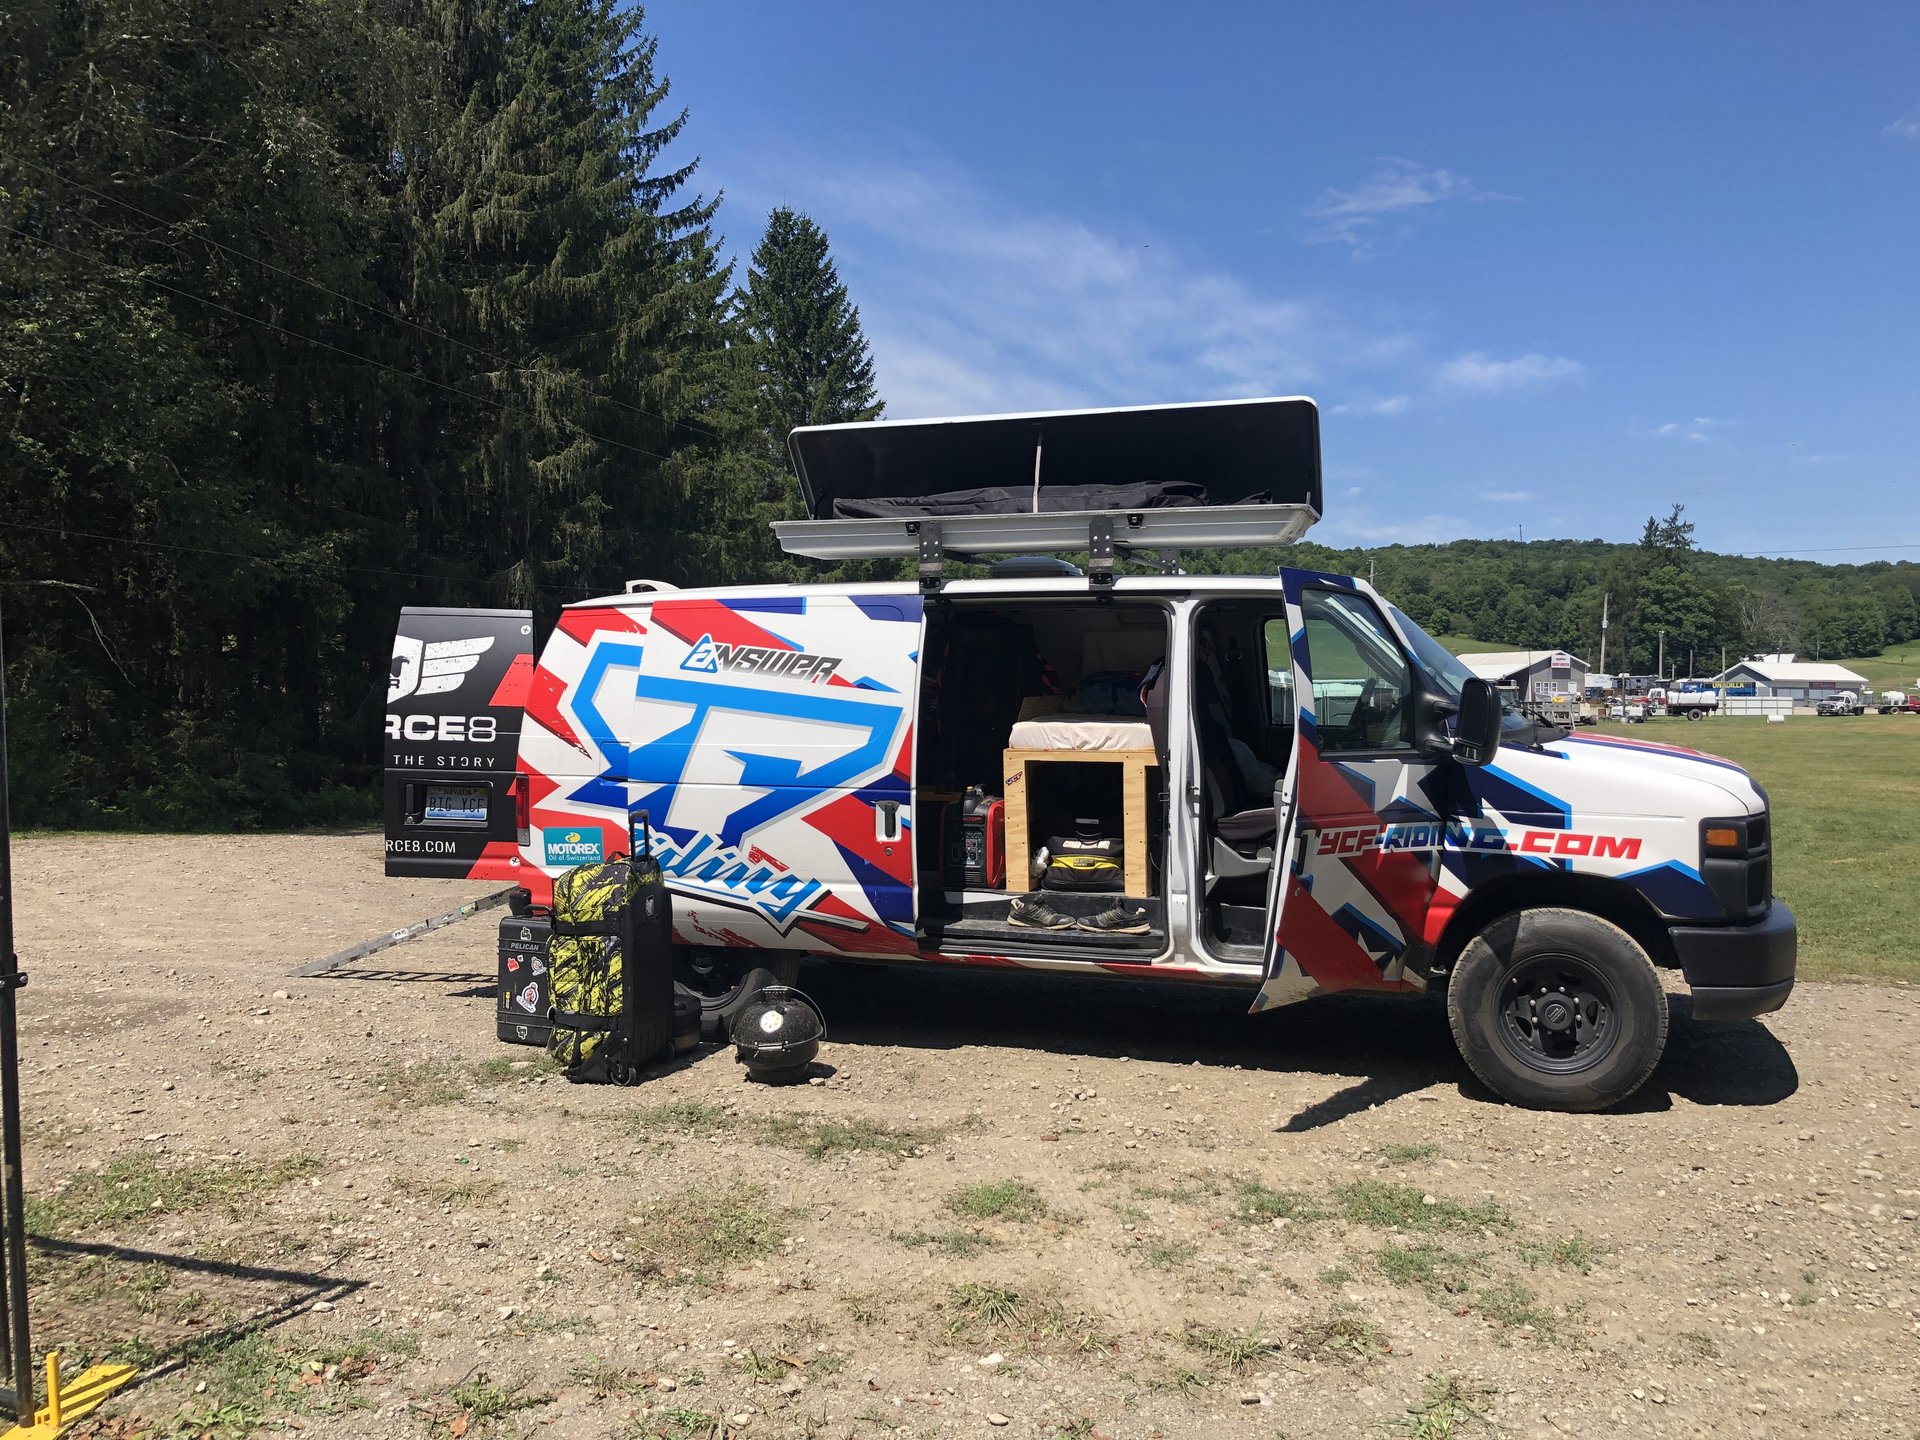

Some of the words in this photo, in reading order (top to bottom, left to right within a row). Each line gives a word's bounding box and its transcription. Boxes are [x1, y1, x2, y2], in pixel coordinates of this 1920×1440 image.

[393, 754, 425, 766] THE
[437, 755, 495, 768] STORY
[429, 797, 452, 812] BIG
[461, 797, 485, 813] YCF
[385, 839, 456, 853] RCE8.COM
[547, 843, 600, 855] MOTOREX
[510, 942, 539, 951] PELICAN
